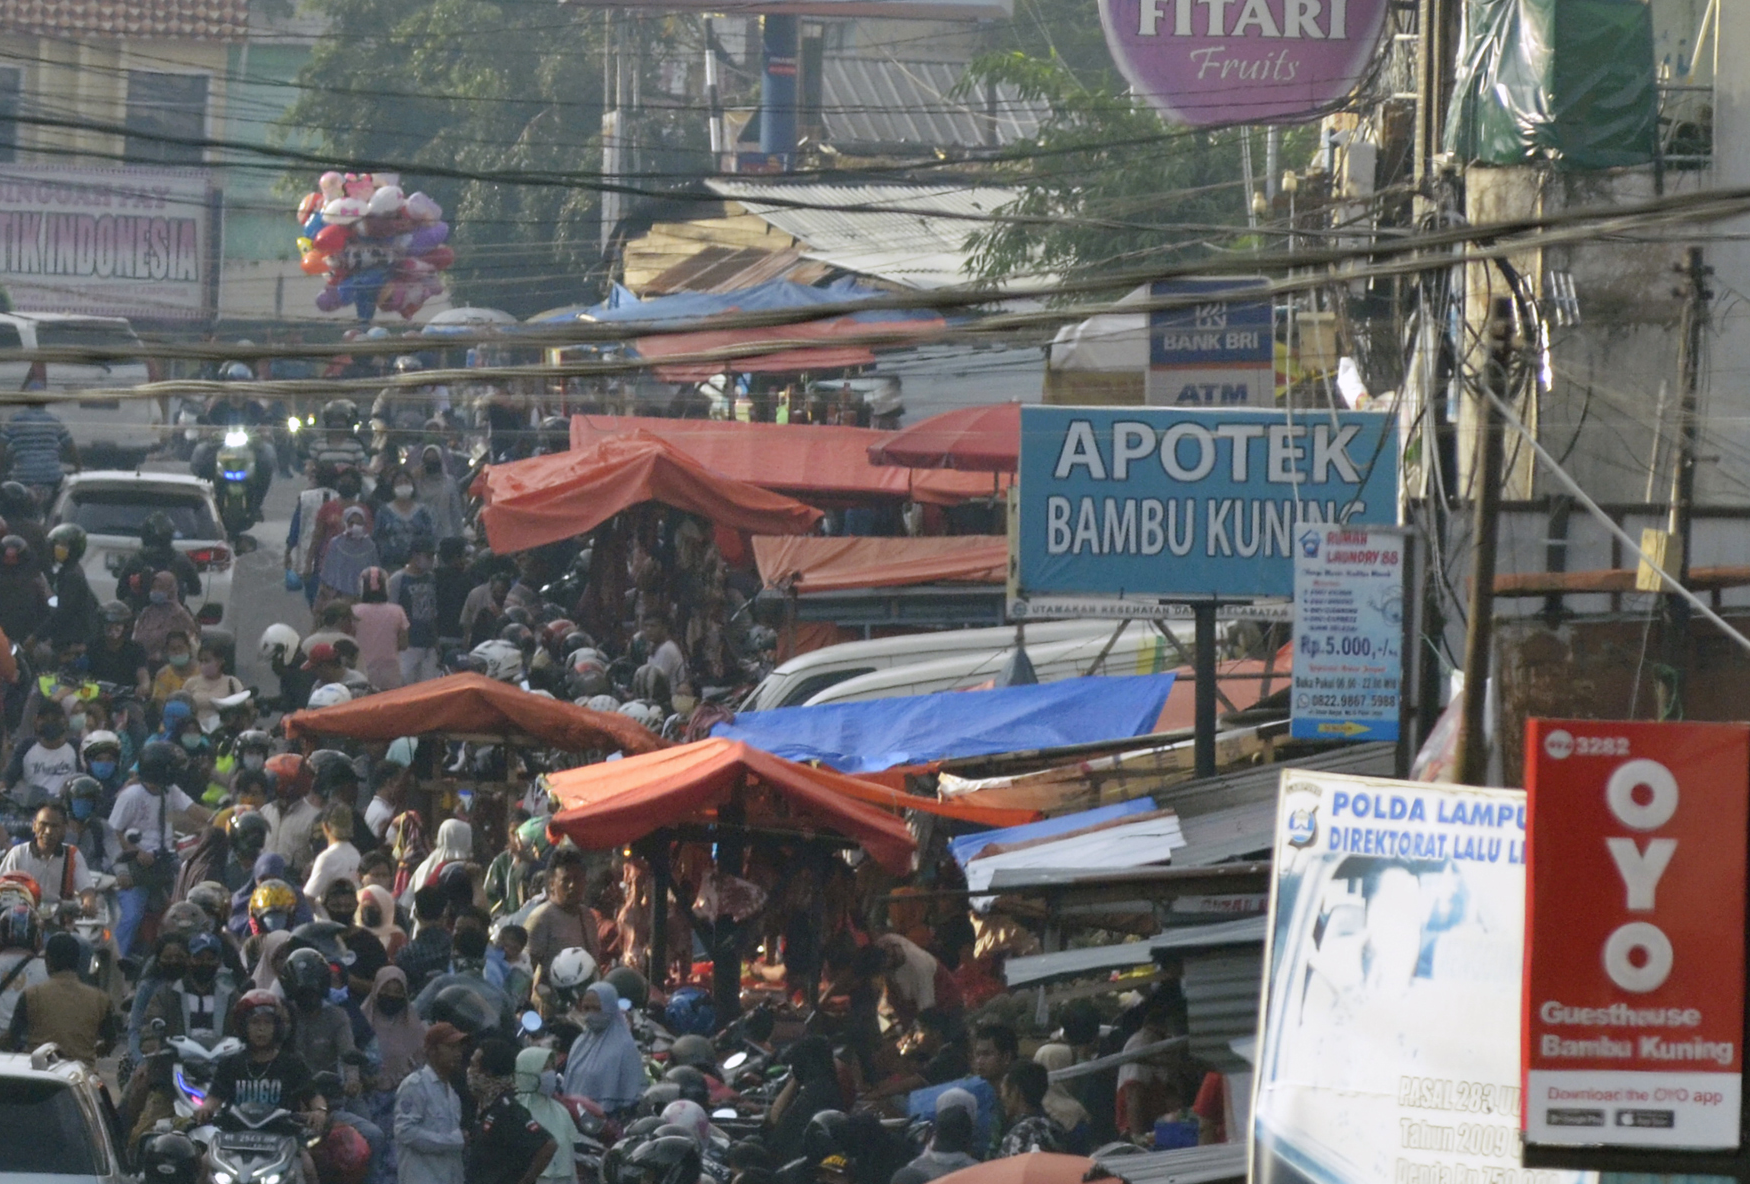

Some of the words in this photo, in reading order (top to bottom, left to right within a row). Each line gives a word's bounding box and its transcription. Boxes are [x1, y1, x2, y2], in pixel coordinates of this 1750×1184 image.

[1137, 0, 1352, 40] FITARI
[1189, 46, 1300, 81] Fruits
[44, 211, 199, 282] INDONESIA
[1163, 333, 1221, 351] BANK
[1225, 332, 1259, 350] BRI
[1173, 382, 1249, 406] ATM
[1053, 420, 1364, 485] APOTEK
[1046, 496, 1196, 557] BAMBU
[1331, 791, 1427, 823] POLDA
[1328, 826, 1448, 862] DIREKTORAT
[1452, 835, 1503, 863] LALU
[1604, 758, 1680, 995] OYO
[1540, 1000, 1702, 1027] Guesthouse
[1541, 1033, 1632, 1058] Bambu
[1639, 1035, 1735, 1065] Kuning
[235, 1080, 282, 1104] HUGO
[1398, 1075, 1453, 1110] PASAL
[1399, 1117, 1454, 1152] Tahun
[1456, 1121, 1509, 1158] 2009
